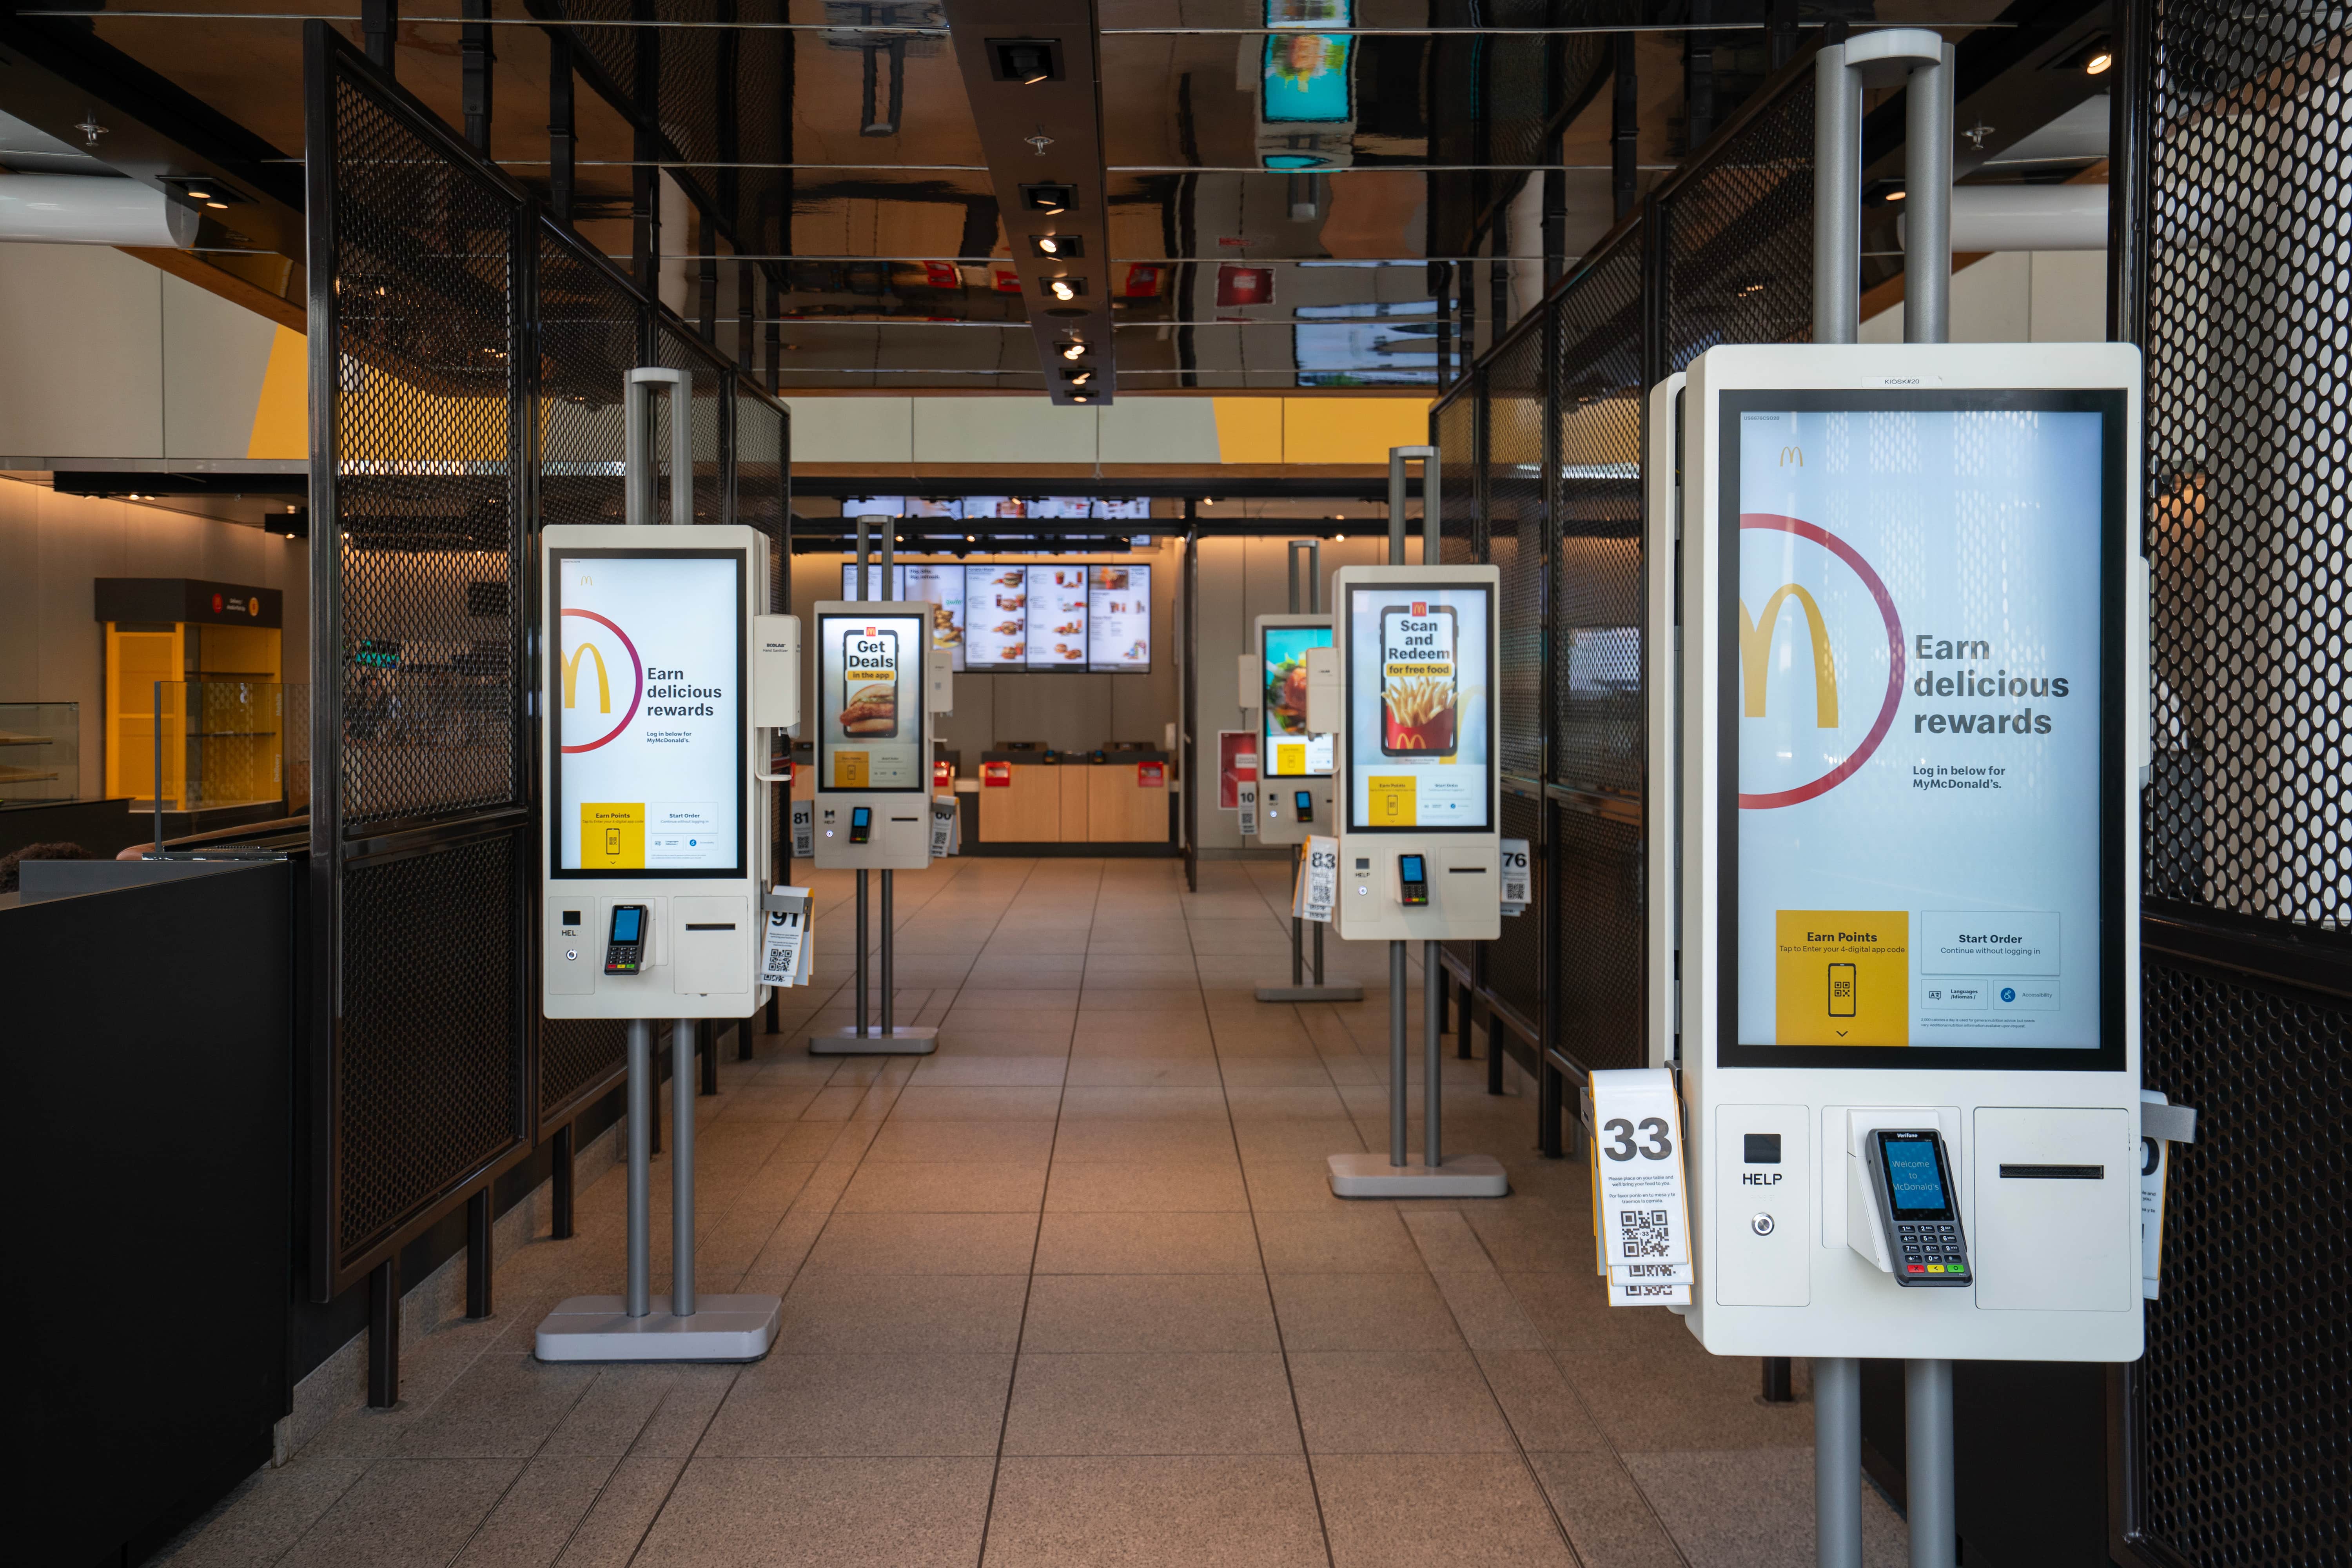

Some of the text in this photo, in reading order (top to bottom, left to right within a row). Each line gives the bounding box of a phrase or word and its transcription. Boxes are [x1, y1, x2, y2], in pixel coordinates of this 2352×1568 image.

[1401, 620, 1438, 632] Scan
[1405, 633, 1433, 646] and
[857, 641, 885, 653] Get
[1916, 635, 1989, 660] Earn
[1389, 648, 1449, 659] Redeem
[849, 655, 894, 668] Deals
[648, 668, 684, 680] Earn
[1389, 665, 1449, 674] for free food
[1914, 669, 2069, 697] delicious
[647, 684, 722, 698] delicious
[648, 703, 713, 716] rewards
[1915, 708, 2052, 734] rewards
[1913, 765, 2005, 777] Log in below for
[1913, 779, 2002, 791] MyMcDonald's.
[1240, 792, 1255, 803] 10
[794, 812, 809, 824] 81
[1503, 853, 1527, 867] 76
[771, 911, 799, 927] 91
[1807, 931, 1877, 942] Earn Points
[1959, 935, 2022, 944] Start Order
[1840, 946, 1870, 954] 4-digital
[2005, 947, 2032, 956] logging
[1603, 1117, 1672, 1162] 33
[1743, 1173, 1782, 1185] HELP
[1892, 1183, 1940, 1191] McDonald's
